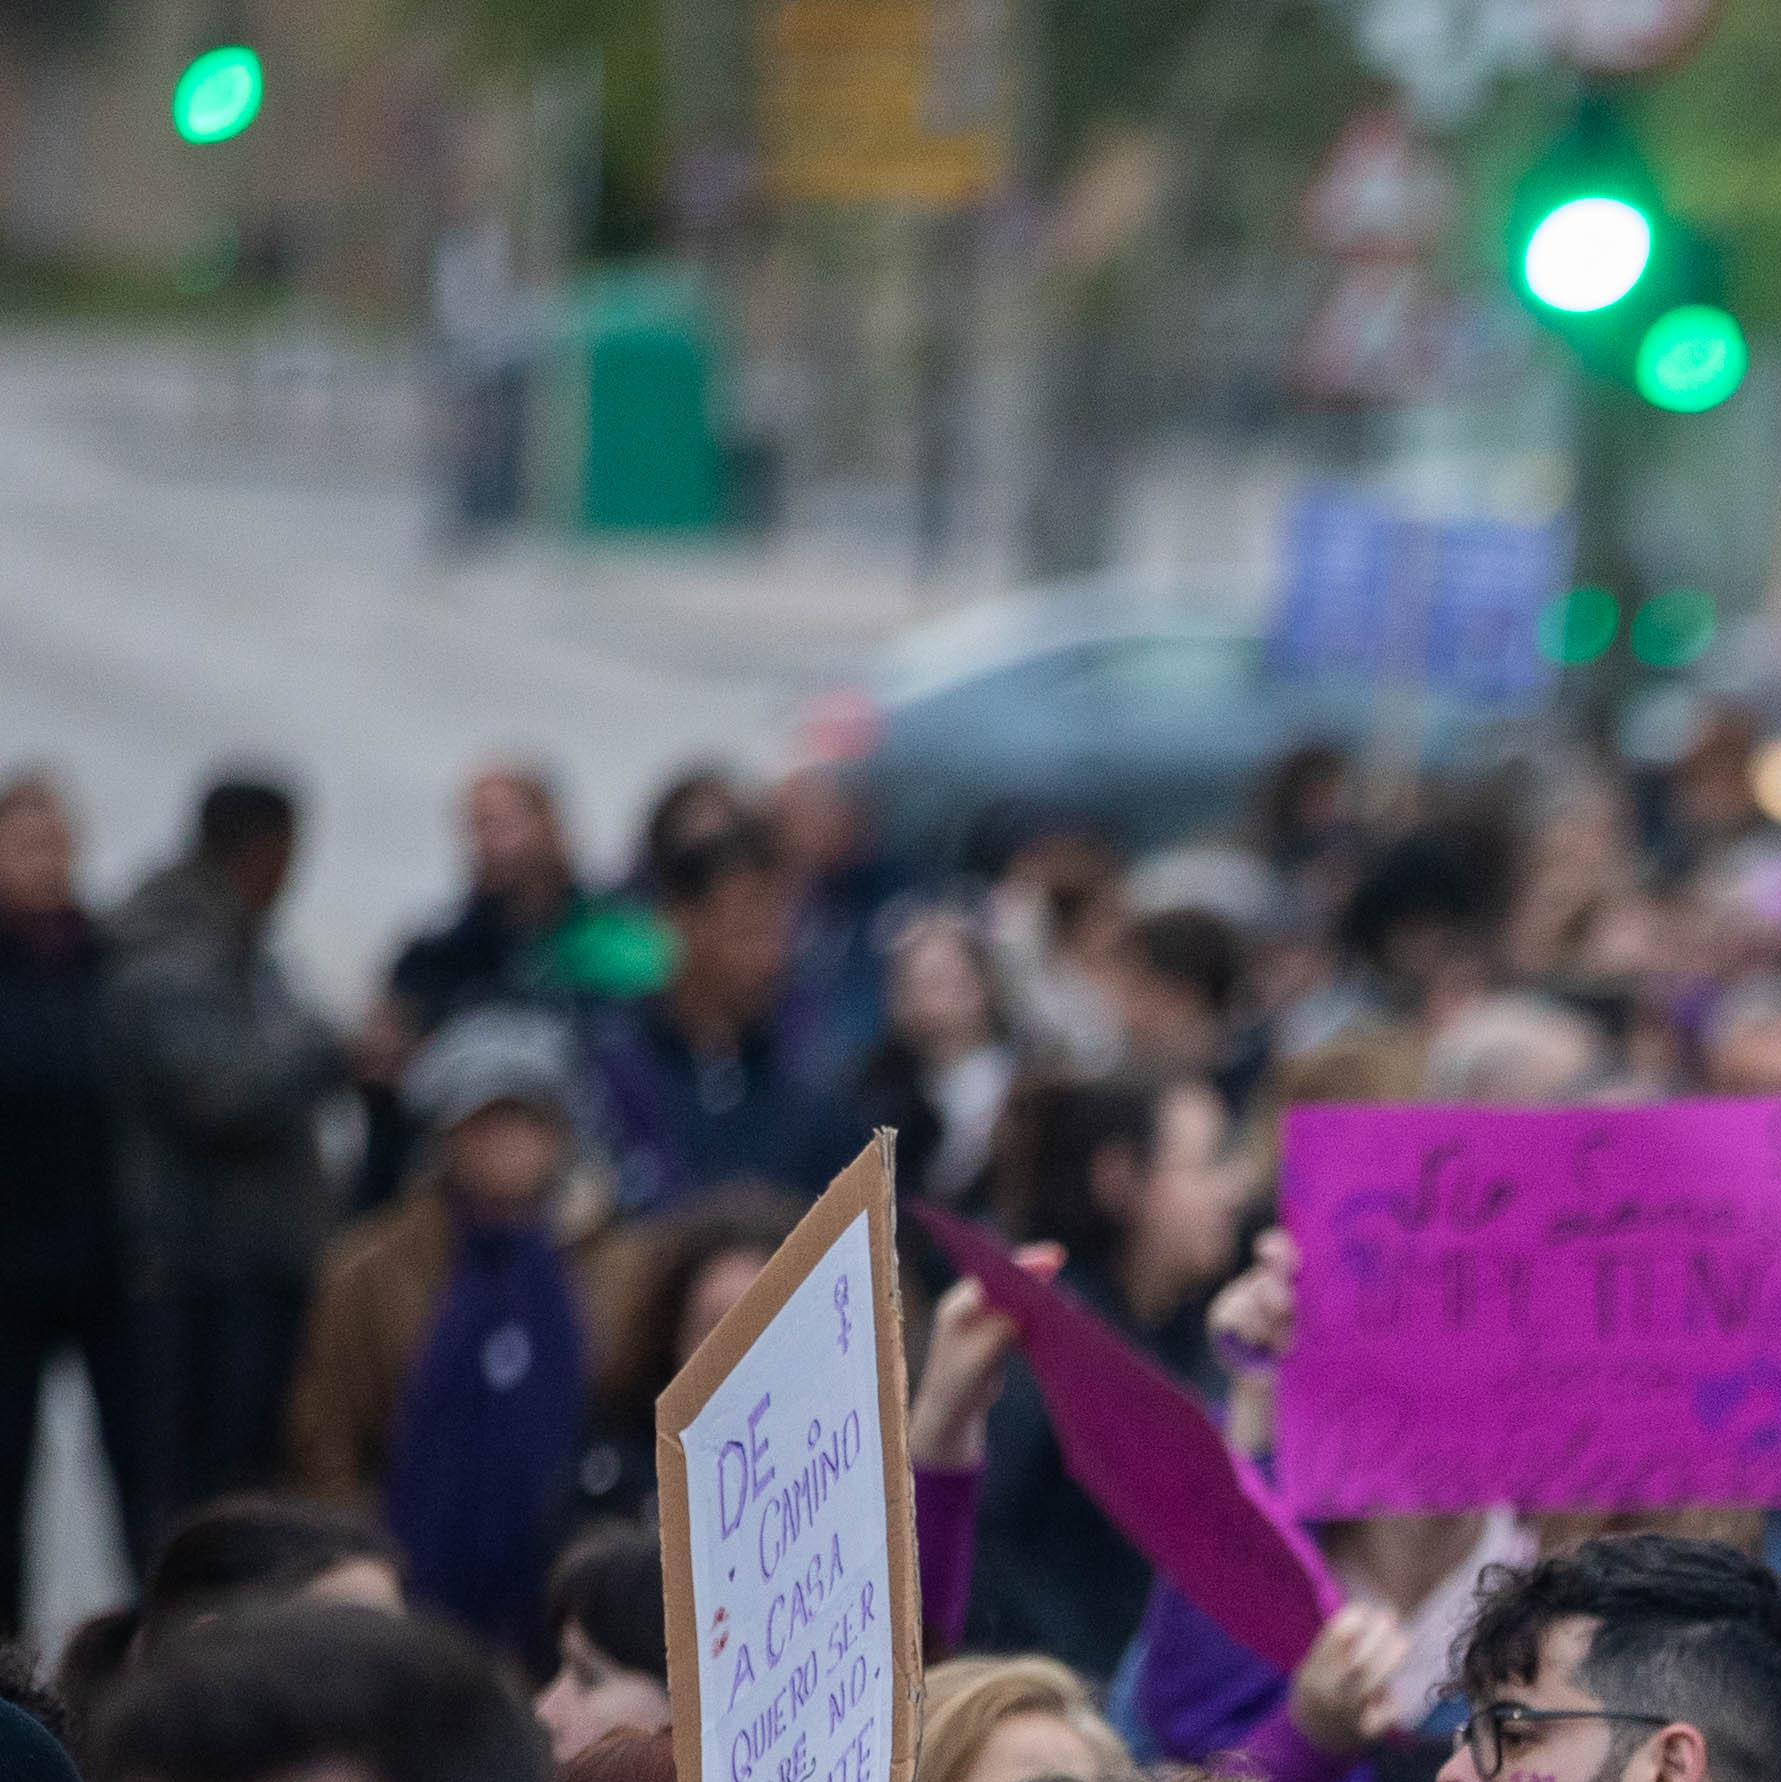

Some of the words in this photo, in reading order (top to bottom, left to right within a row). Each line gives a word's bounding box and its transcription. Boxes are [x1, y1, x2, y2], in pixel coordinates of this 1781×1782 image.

[717, 1392, 776, 1541] DE
[760, 1409, 861, 1584] CAMINO
[728, 1642, 756, 1714] A
[766, 1532, 844, 1670] CASA
[825, 1580, 875, 1678] SER
